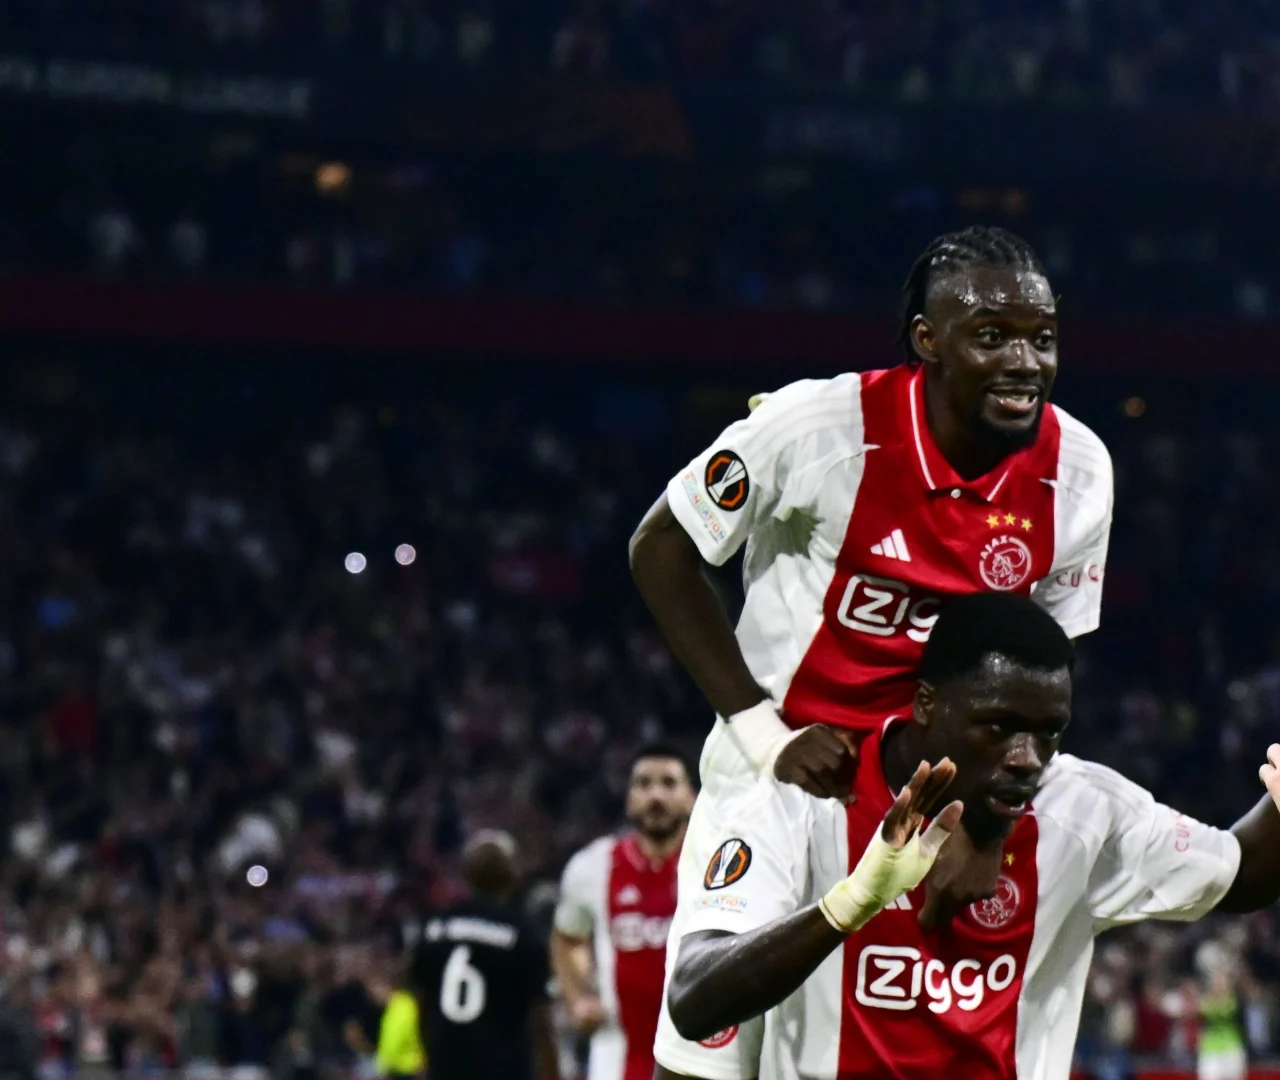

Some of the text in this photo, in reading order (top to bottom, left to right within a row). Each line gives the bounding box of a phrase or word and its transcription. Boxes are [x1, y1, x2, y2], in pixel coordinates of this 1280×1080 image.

[980, 535, 1008, 560] AJAX
[837, 574, 940, 642] Zig
[439, 946, 487, 1024] 6
[855, 945, 1017, 1013] Ziggo
